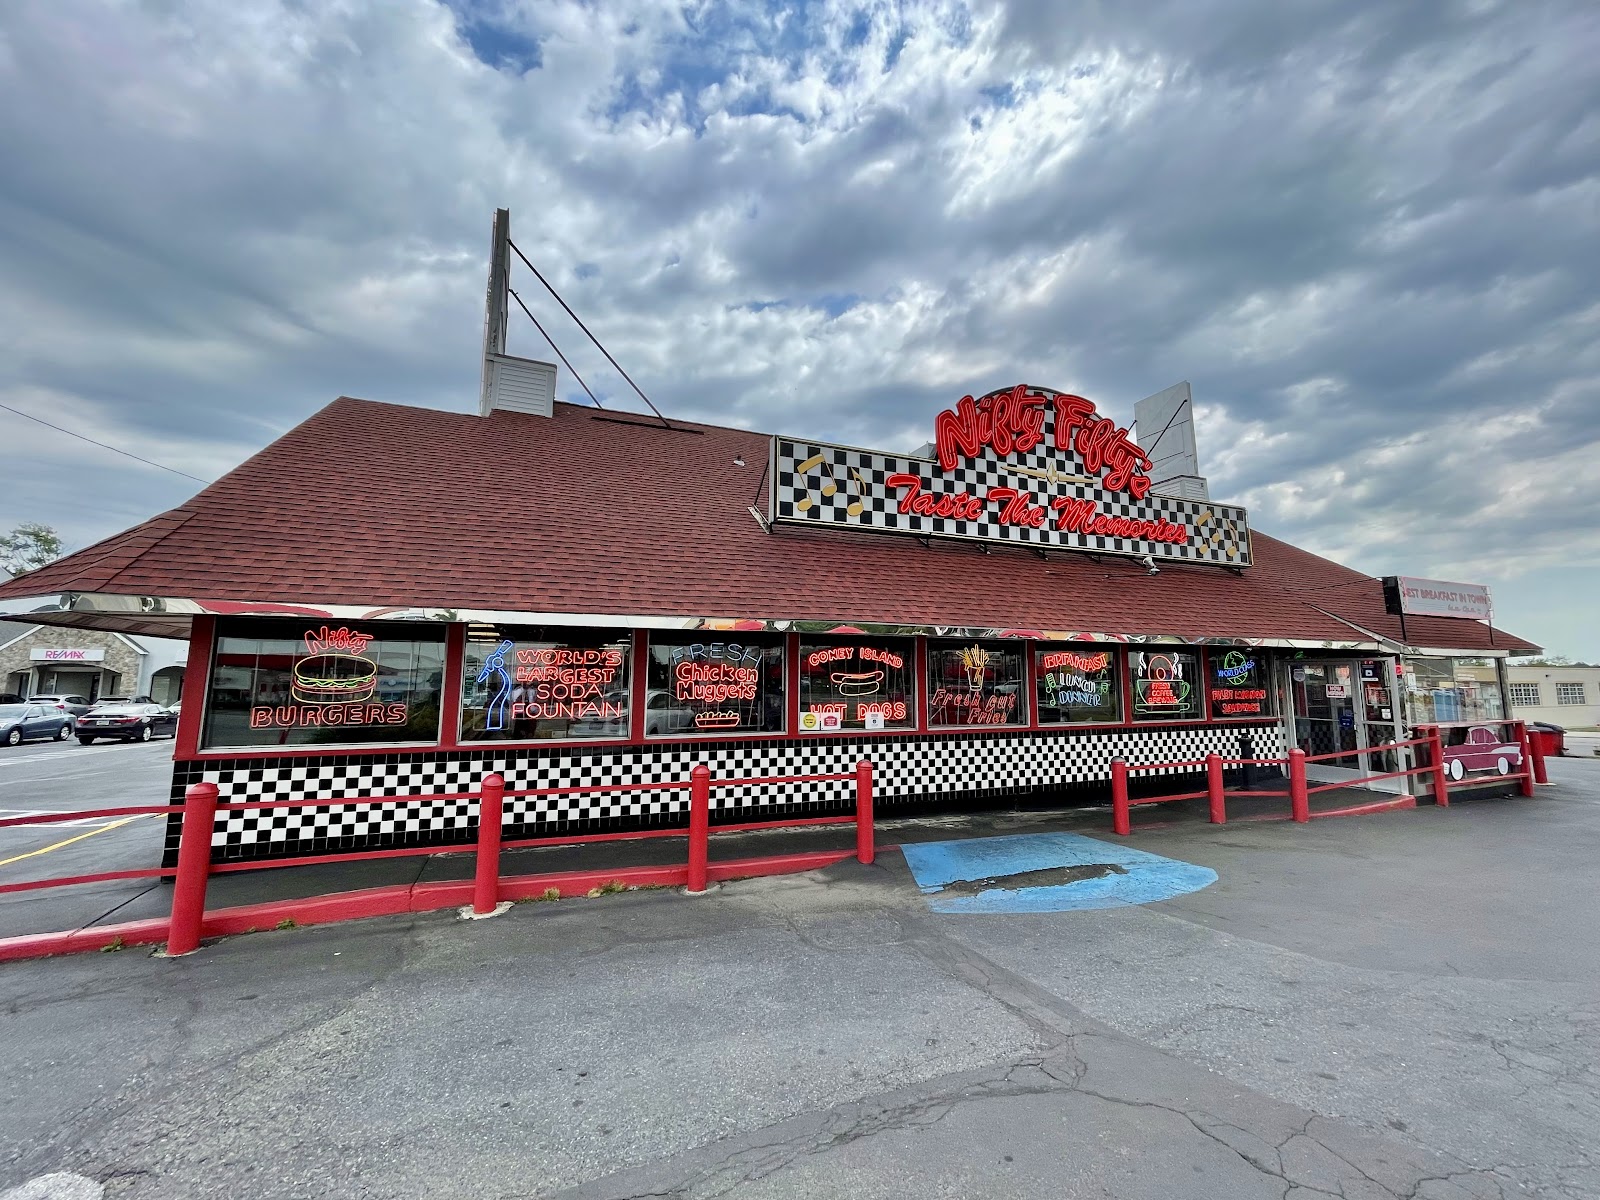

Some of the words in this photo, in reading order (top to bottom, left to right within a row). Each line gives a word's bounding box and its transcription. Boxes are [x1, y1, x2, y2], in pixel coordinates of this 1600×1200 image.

[935, 384, 1047, 472] Nifty
[1054, 394, 1153, 500] Fifty's
[886, 474, 983, 519] Taste
[987, 486, 1046, 527] The
[1051, 496, 1189, 544] Memories
[1420, 589, 1457, 602] BREAKFAST
[1459, 593, 1467, 603] IN
[305, 626, 374, 655] Nifty
[45, 650, 85, 659] RE/MAX
[517, 650, 622, 666] WORLD'S
[672, 643, 762, 669] FRESH
[809, 647, 854, 666] CONEY
[860, 647, 903, 668] ISLAND
[1044, 653, 1107, 672] BREAKFAST
[516, 666, 615, 684] LARGEST
[676, 661, 758, 682] Chicken
[1217, 667, 1239, 677] WORLD
[1238, 660, 1256, 674] CLASS
[537, 684, 604, 699] SODA
[677, 681, 757, 702] Nuggets
[1060, 672, 1096, 693] LUNCH
[931, 689, 981, 706] Fresh
[1059, 690, 1102, 706] DINNER
[251, 703, 407, 728] BURGERS
[511, 702, 621, 719] FOUNTAIN
[857, 702, 906, 721] DOGS
[967, 708, 1006, 724] Fries
